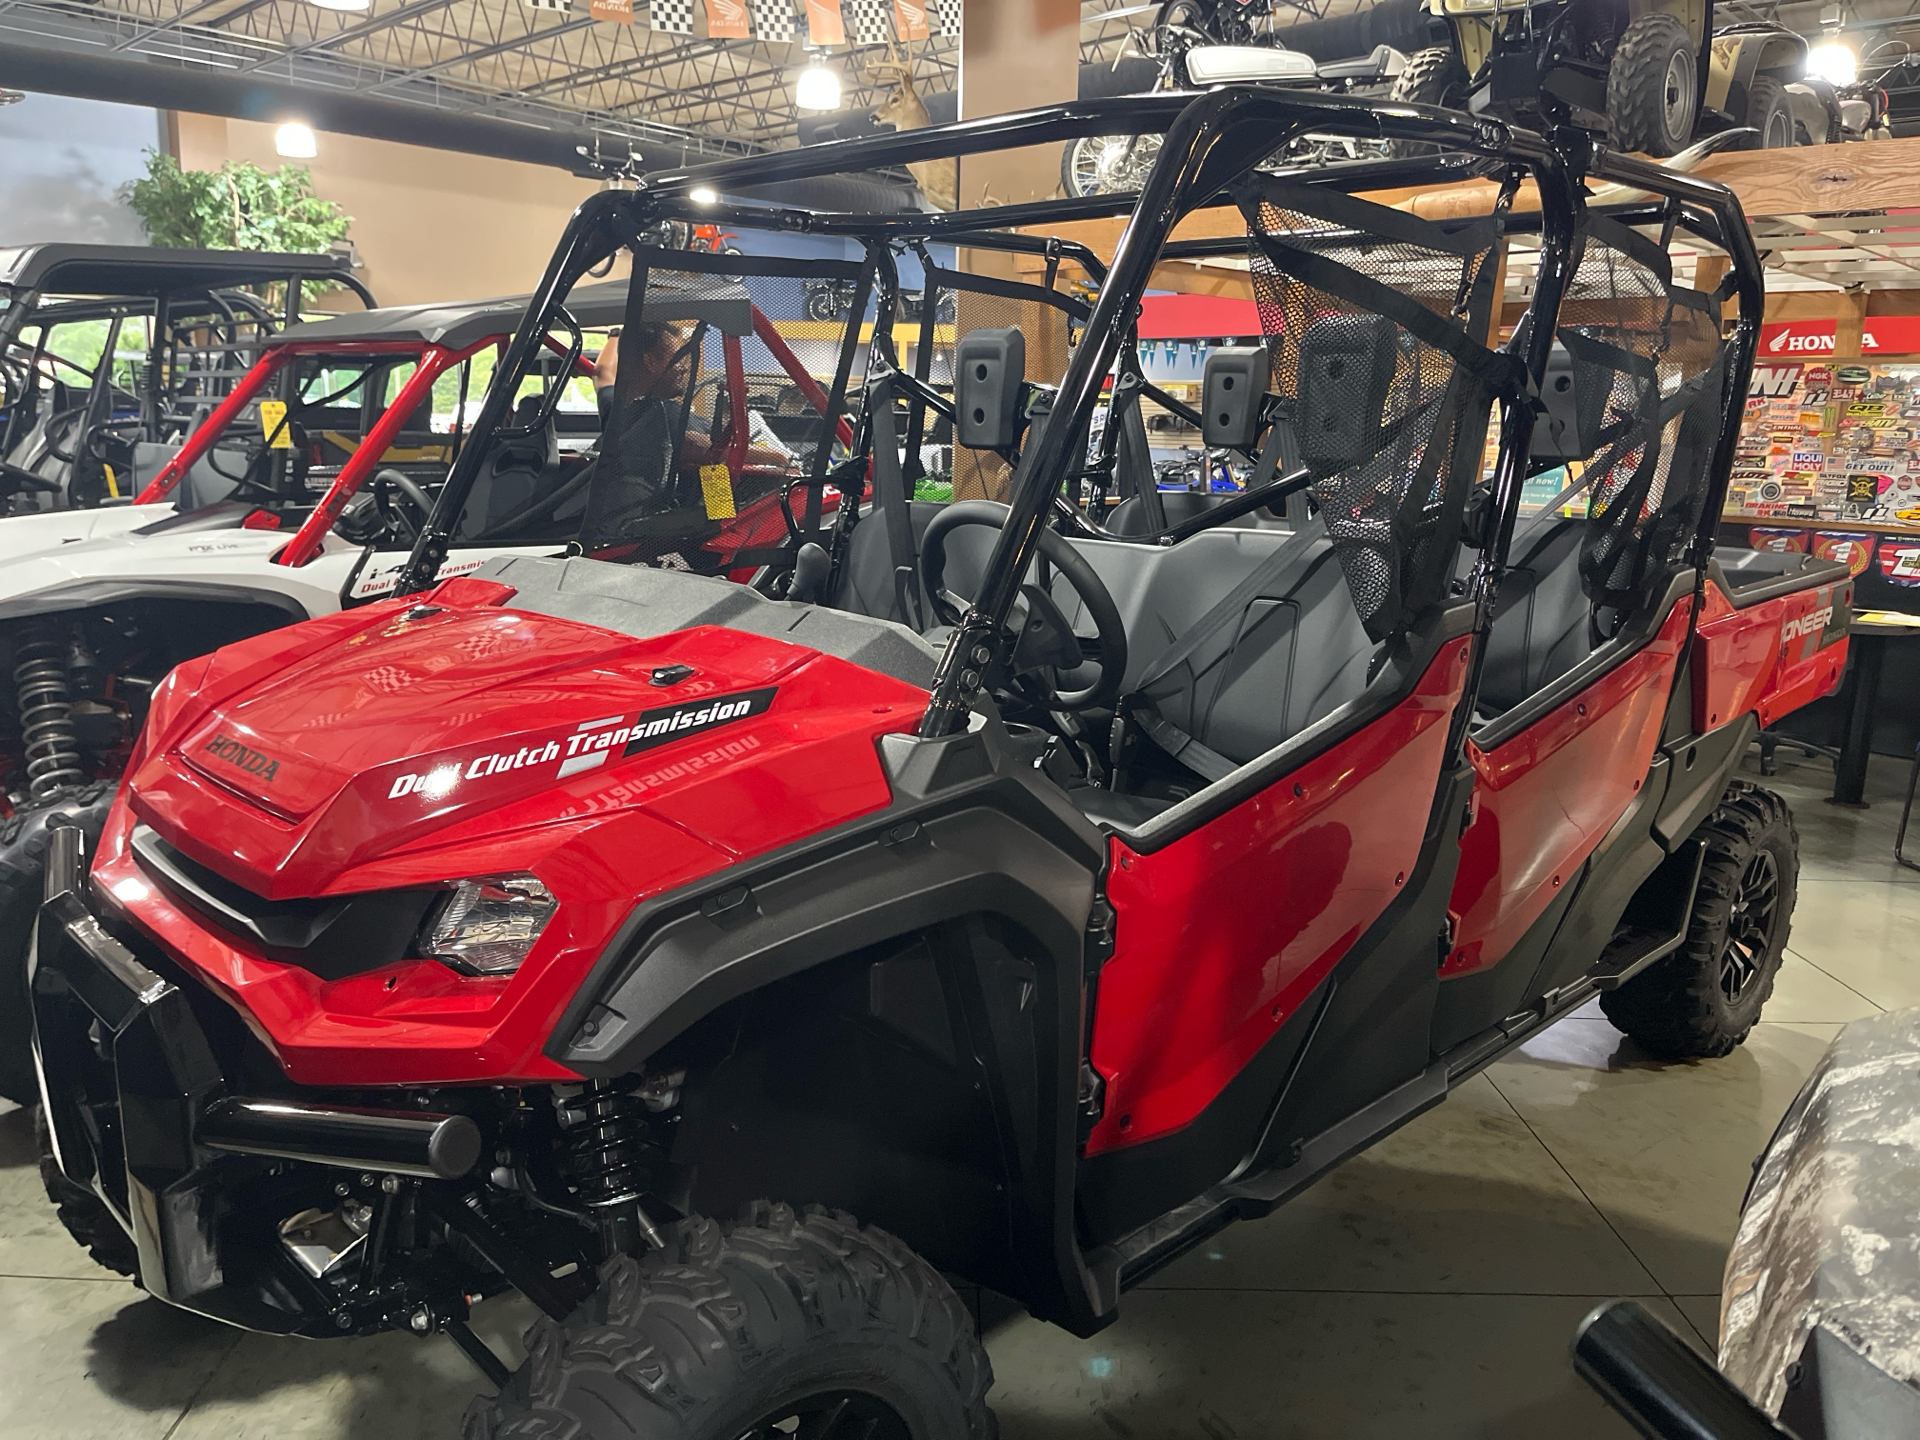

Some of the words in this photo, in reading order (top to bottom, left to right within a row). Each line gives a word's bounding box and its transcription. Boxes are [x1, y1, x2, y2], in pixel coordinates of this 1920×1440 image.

[1787, 333, 1879, 351] HONA
[1808, 372, 1829, 380] NGK
[1748, 398, 1766, 408] RK
[1794, 454, 1822, 462] LIQUI
[1793, 463, 1822, 471] MOLY
[361, 580, 389, 593] Dual
[464, 740, 560, 780] Clutch
[566, 700, 752, 756] Transmission
[204, 734, 281, 782] HONDA
